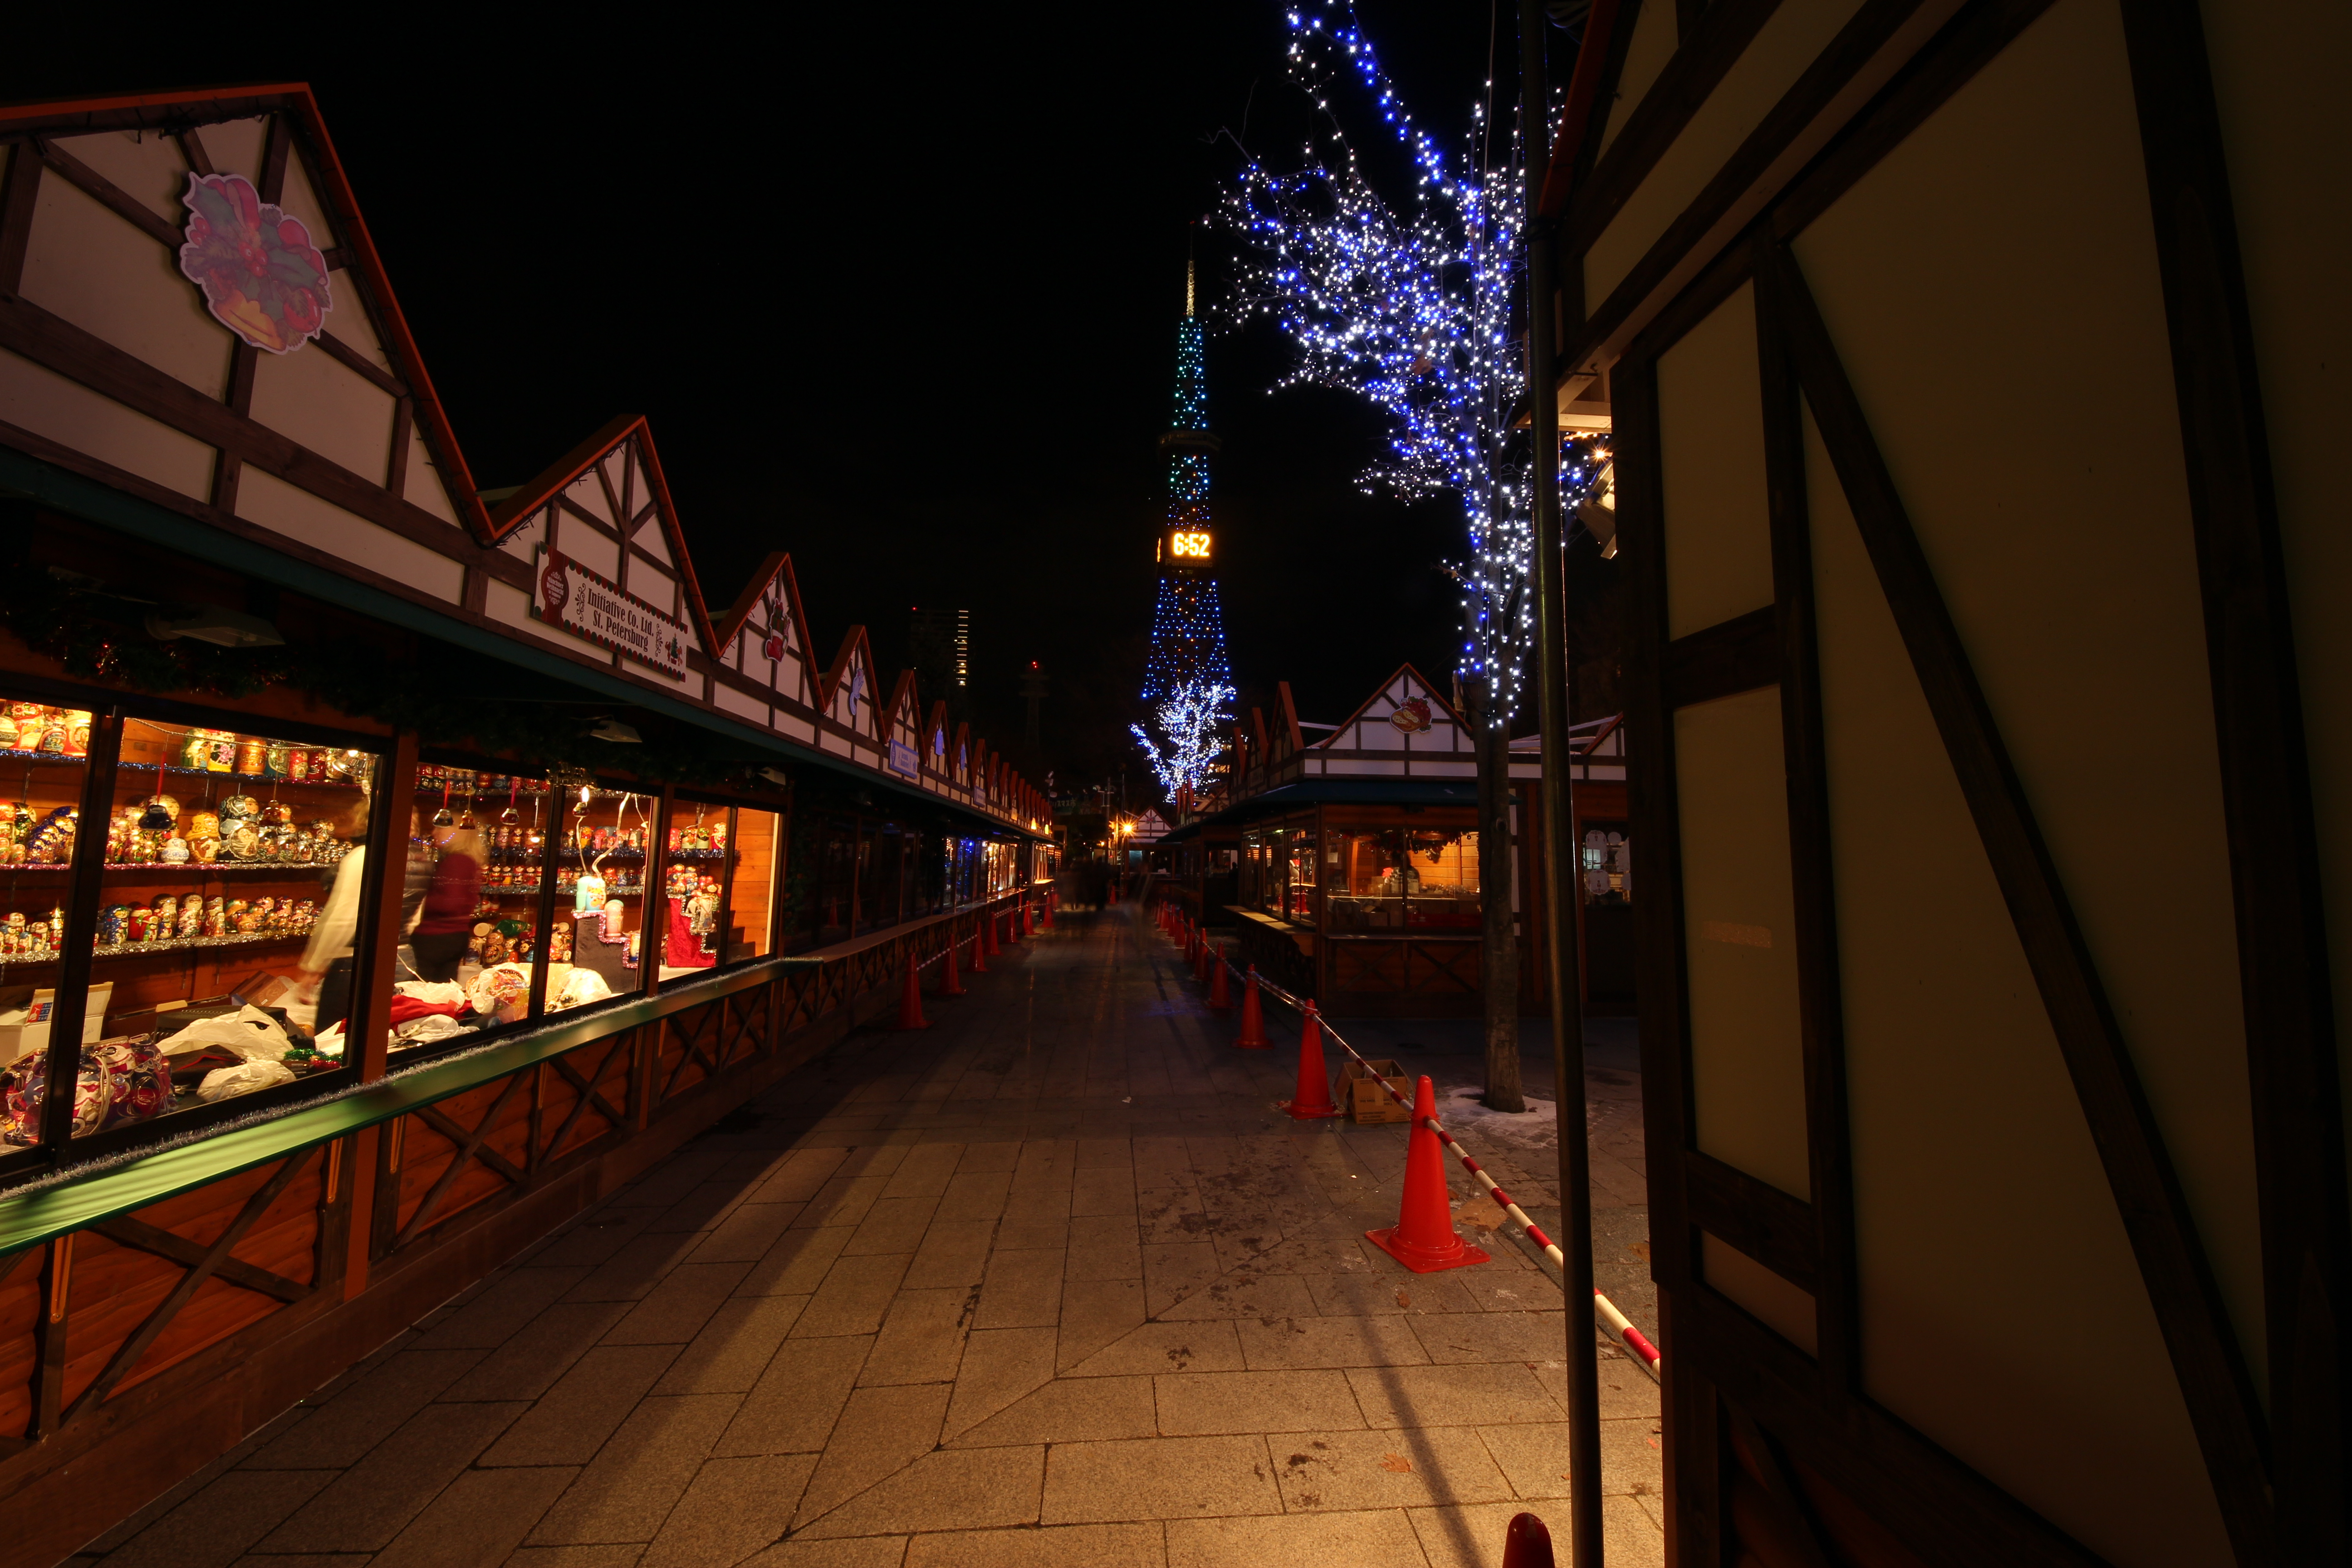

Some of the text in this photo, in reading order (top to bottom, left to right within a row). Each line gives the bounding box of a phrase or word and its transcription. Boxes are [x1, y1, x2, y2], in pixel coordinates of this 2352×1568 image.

[1173, 533, 1210, 556] 6:52
[1165, 558, 1213, 568] Panasonic
[588, 588, 653, 637] Initiative Co. Ltd.
[593, 610, 648, 652] St. Petersburg
